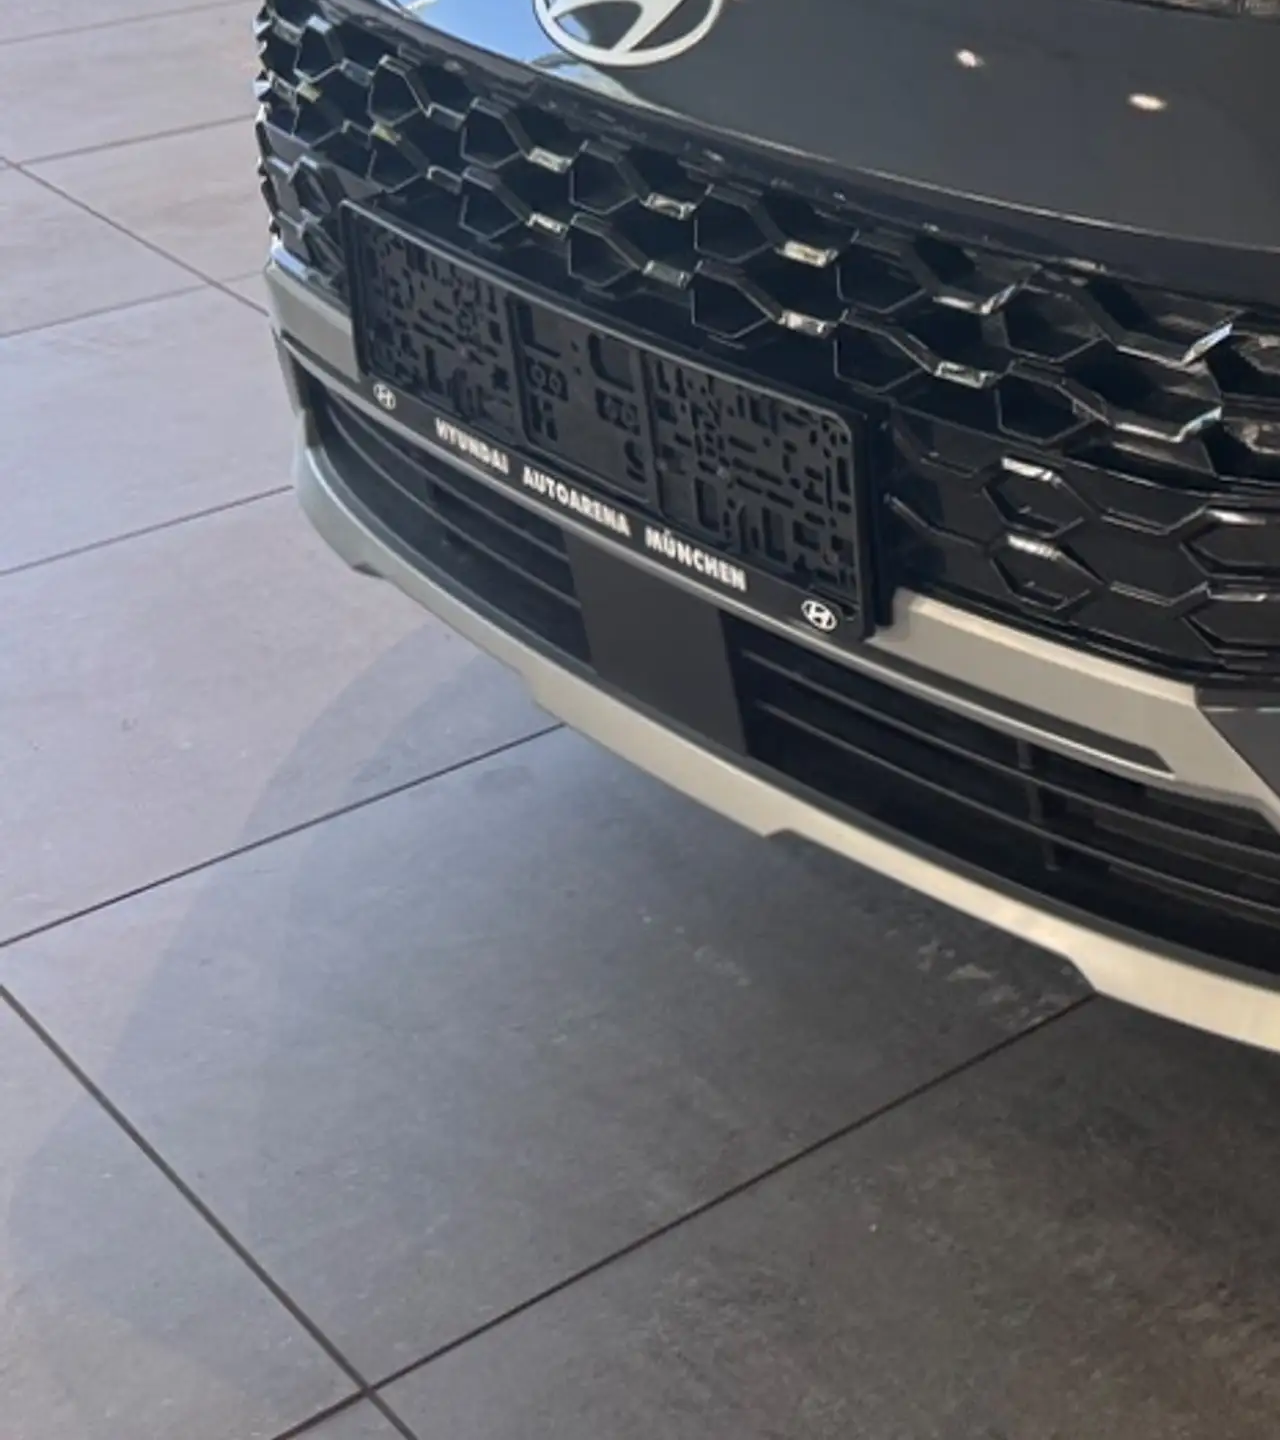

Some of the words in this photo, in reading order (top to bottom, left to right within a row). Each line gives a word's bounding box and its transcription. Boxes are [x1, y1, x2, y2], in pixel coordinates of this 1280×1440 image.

[435, 416, 509, 475] HYUNDAI
[523, 466, 631, 537] AUTOARENA
[645, 526, 747, 592] MÜNCHEN
